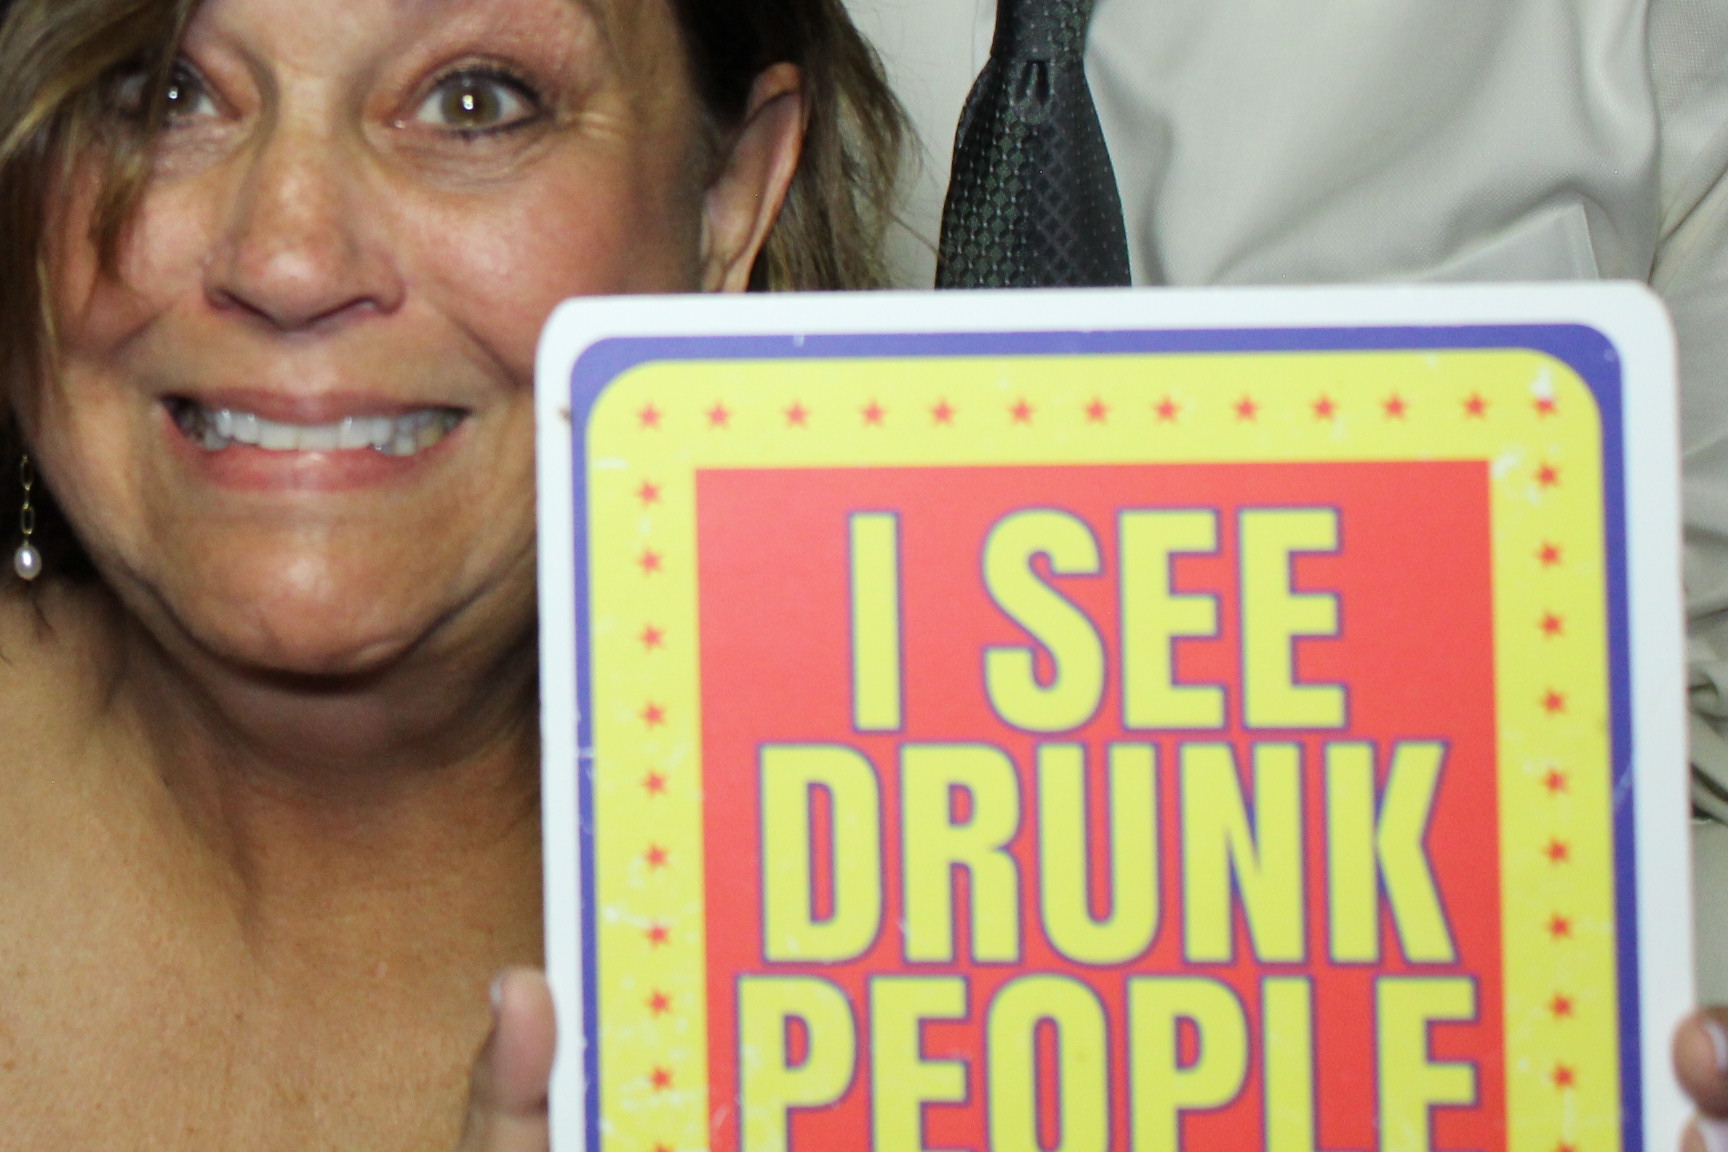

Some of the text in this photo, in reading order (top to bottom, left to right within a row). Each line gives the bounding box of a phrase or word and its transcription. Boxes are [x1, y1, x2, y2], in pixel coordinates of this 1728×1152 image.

[849, 507, 1348, 733] I SEE
[759, 740, 1457, 965] DRUNK
[736, 973, 1480, 1152] PEOPLE
